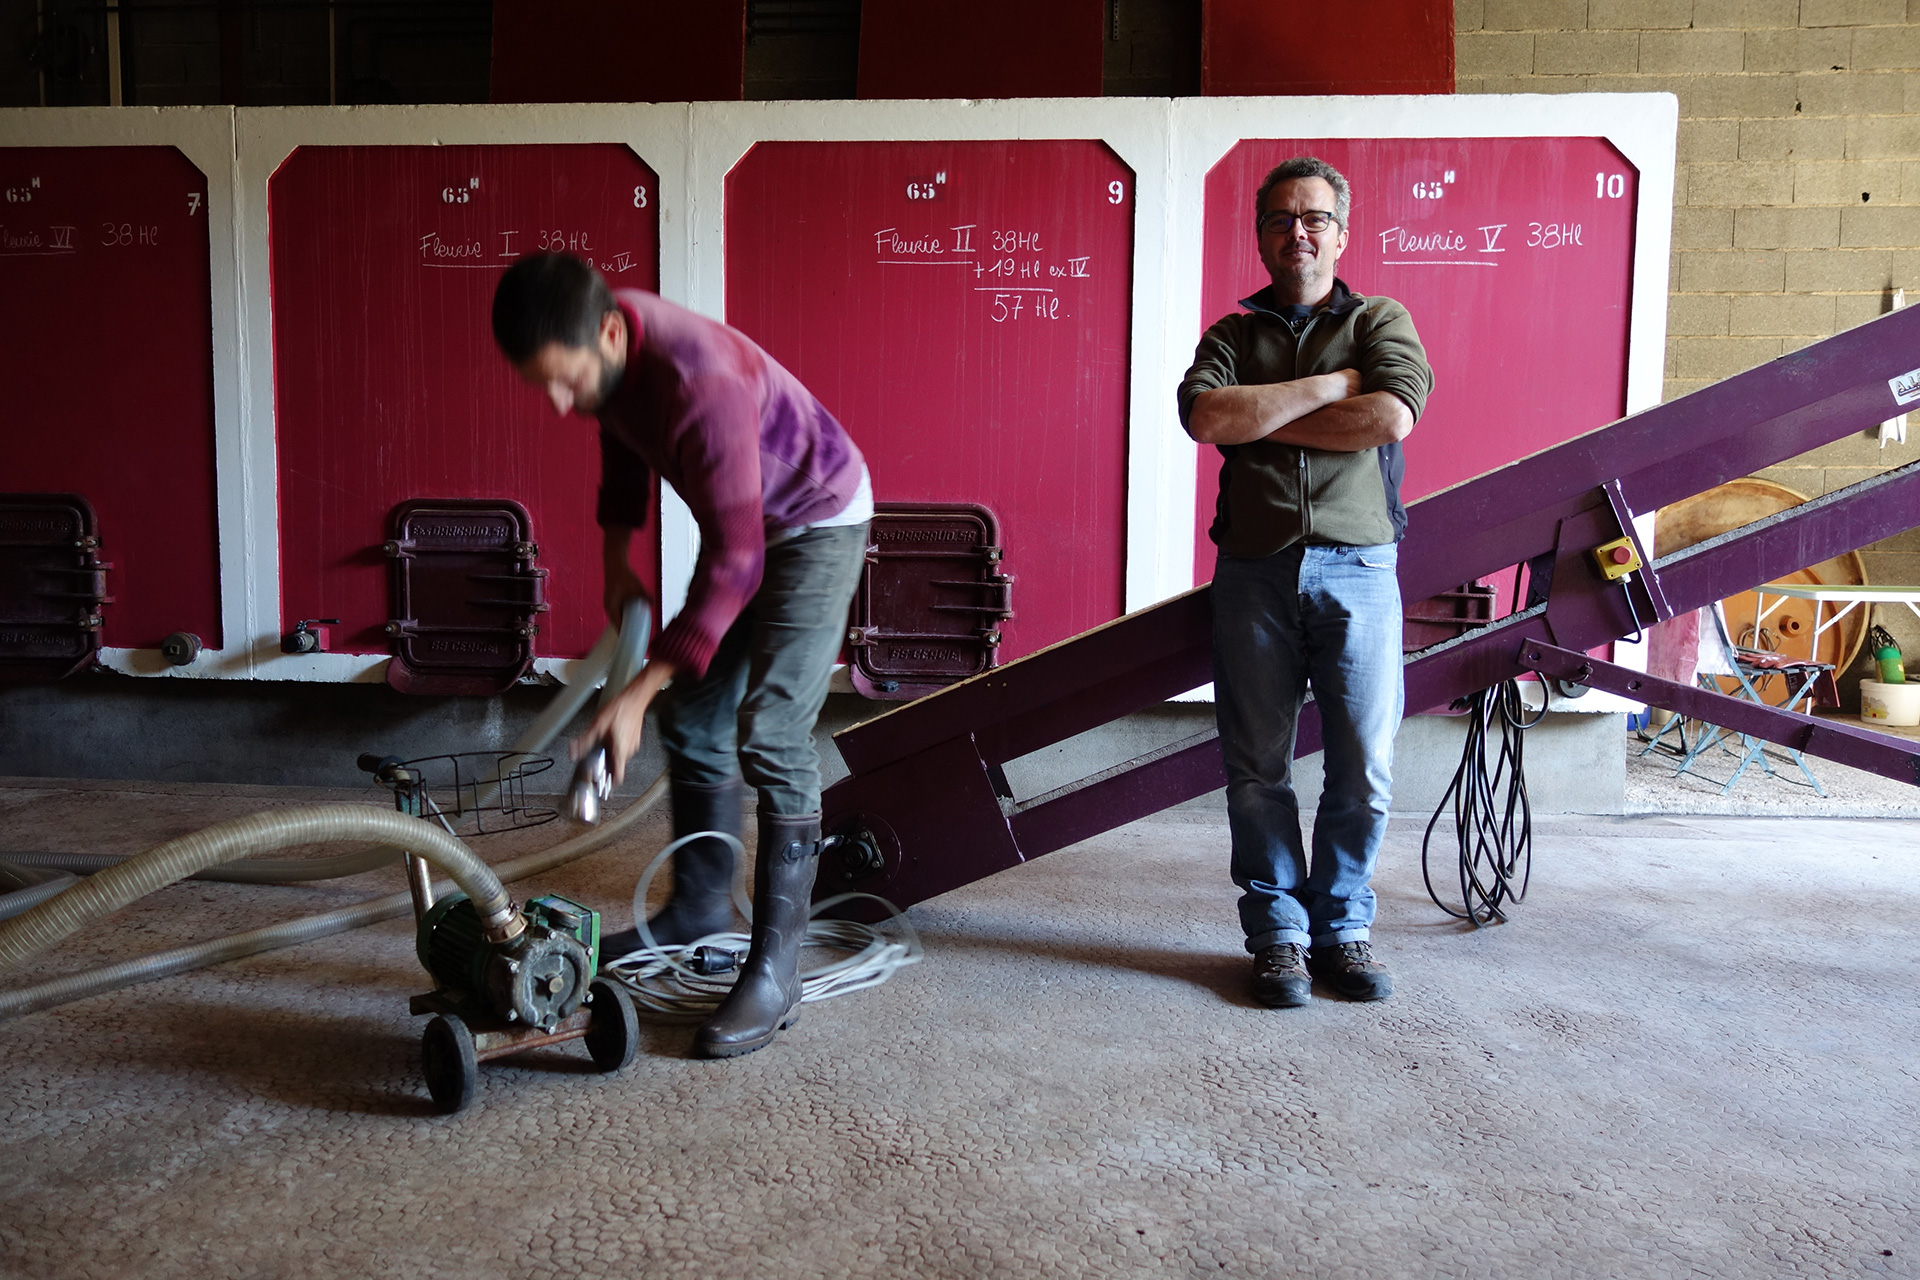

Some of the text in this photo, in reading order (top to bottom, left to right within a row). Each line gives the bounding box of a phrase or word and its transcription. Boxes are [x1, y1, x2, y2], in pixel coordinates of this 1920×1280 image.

[633, 185, 648, 208] 8
[1107, 180, 1124, 204] 9
[1595, 172, 1624, 199] 10
[187, 193, 200, 216] 7
[0, 224, 43, 249] leurie
[50, 225, 77, 249] VI
[419, 232, 483, 258] Fleurie
[498, 230, 520, 257] I
[874, 227, 944, 254] Fleurie
[950, 224, 977, 252] II
[1379, 226, 1467, 253] Fleurie
[1476, 223, 1507, 252] V
[990, 294, 1024, 322] 57
